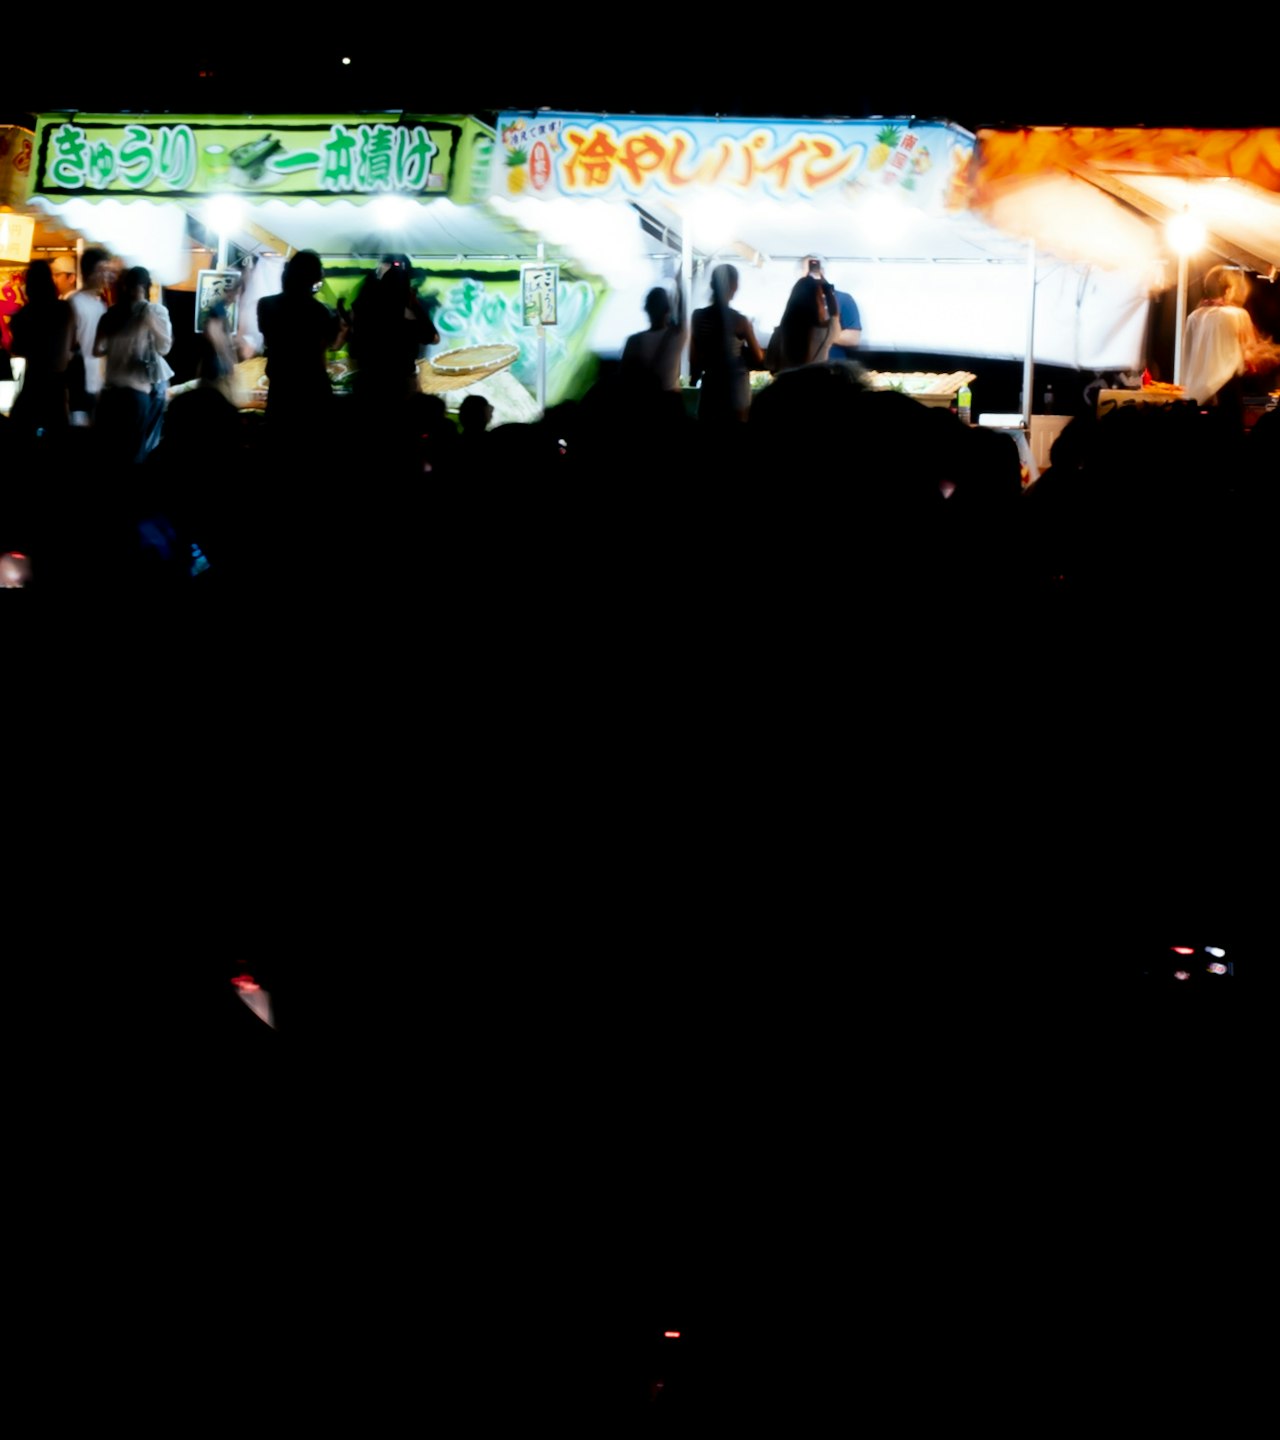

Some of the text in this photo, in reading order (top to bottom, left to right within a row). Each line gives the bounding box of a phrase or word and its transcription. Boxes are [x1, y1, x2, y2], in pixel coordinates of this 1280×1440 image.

[52, 125, 197, 189] きゅうり
[269, 125, 437, 191] 一本漬け
[564, 128, 856, 188] 冷やしパイン
